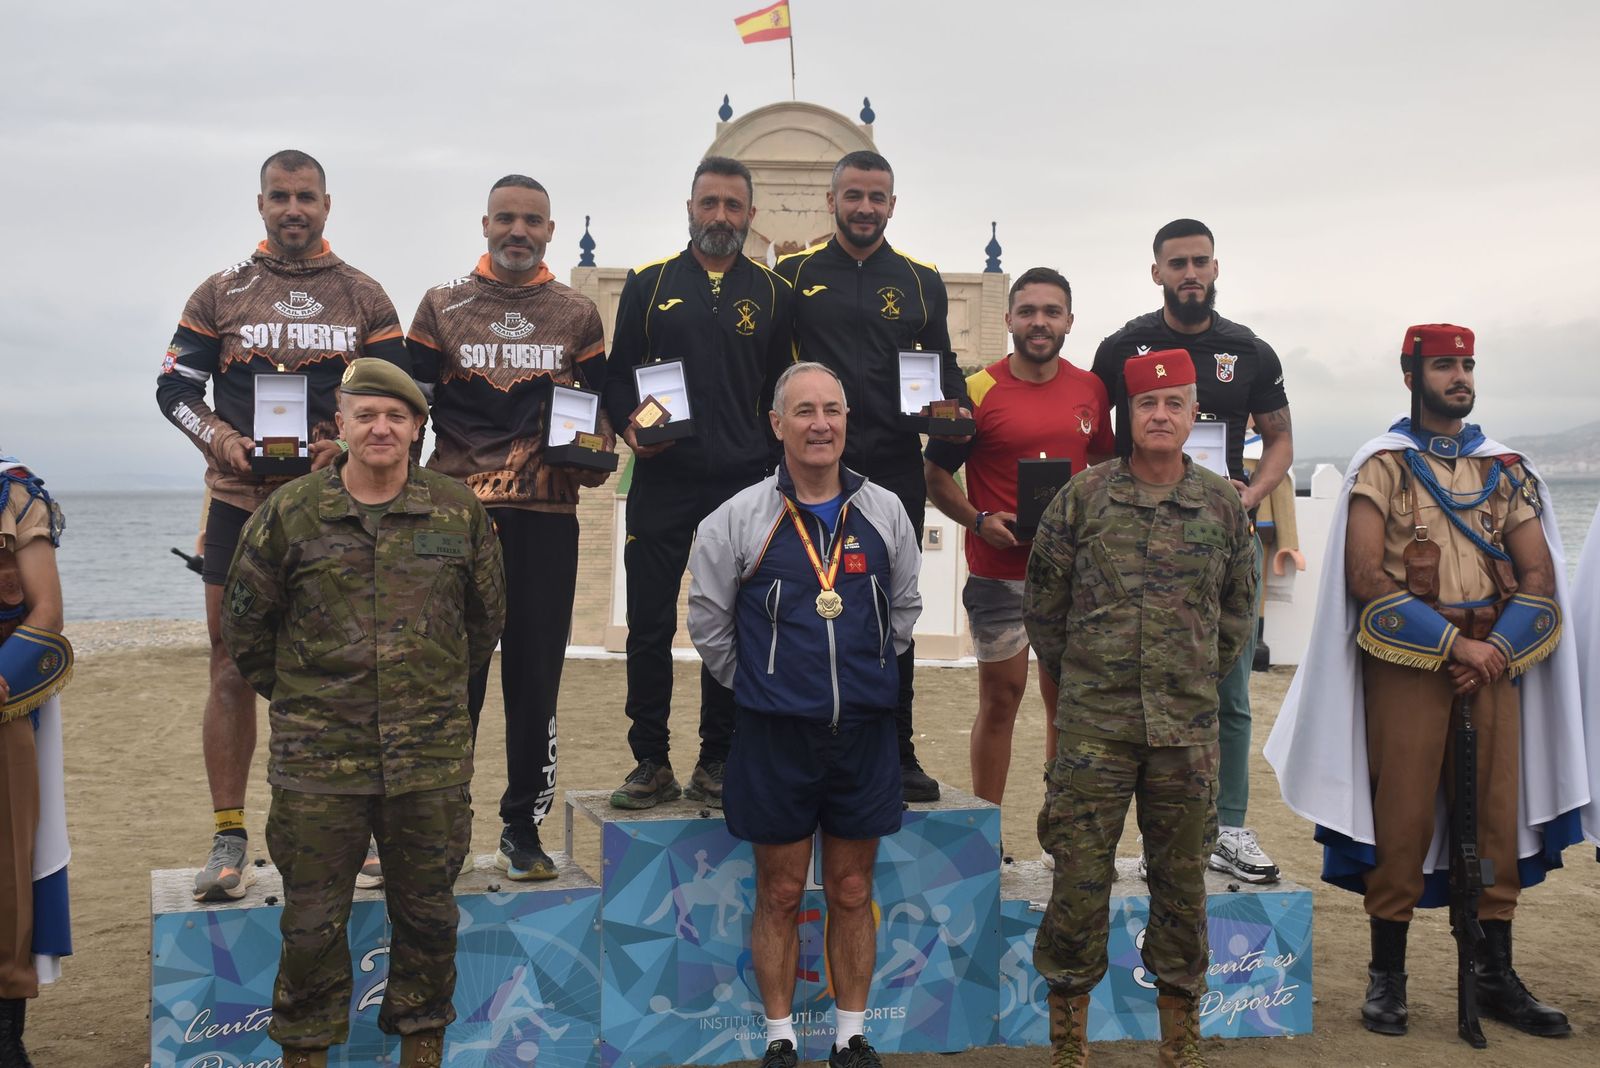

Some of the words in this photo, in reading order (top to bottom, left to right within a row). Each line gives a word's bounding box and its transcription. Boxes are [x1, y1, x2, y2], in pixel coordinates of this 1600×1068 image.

[240, 322, 283, 349] SOY
[459, 343, 499, 369] SOY
[1273, 952, 1298, 969] es
[699, 1014, 767, 1030] INSTITUTO
[815, 1011, 833, 1024] DE
[863, 1006, 906, 1021] ORTES
[1199, 984, 1299, 1026] Deporte
